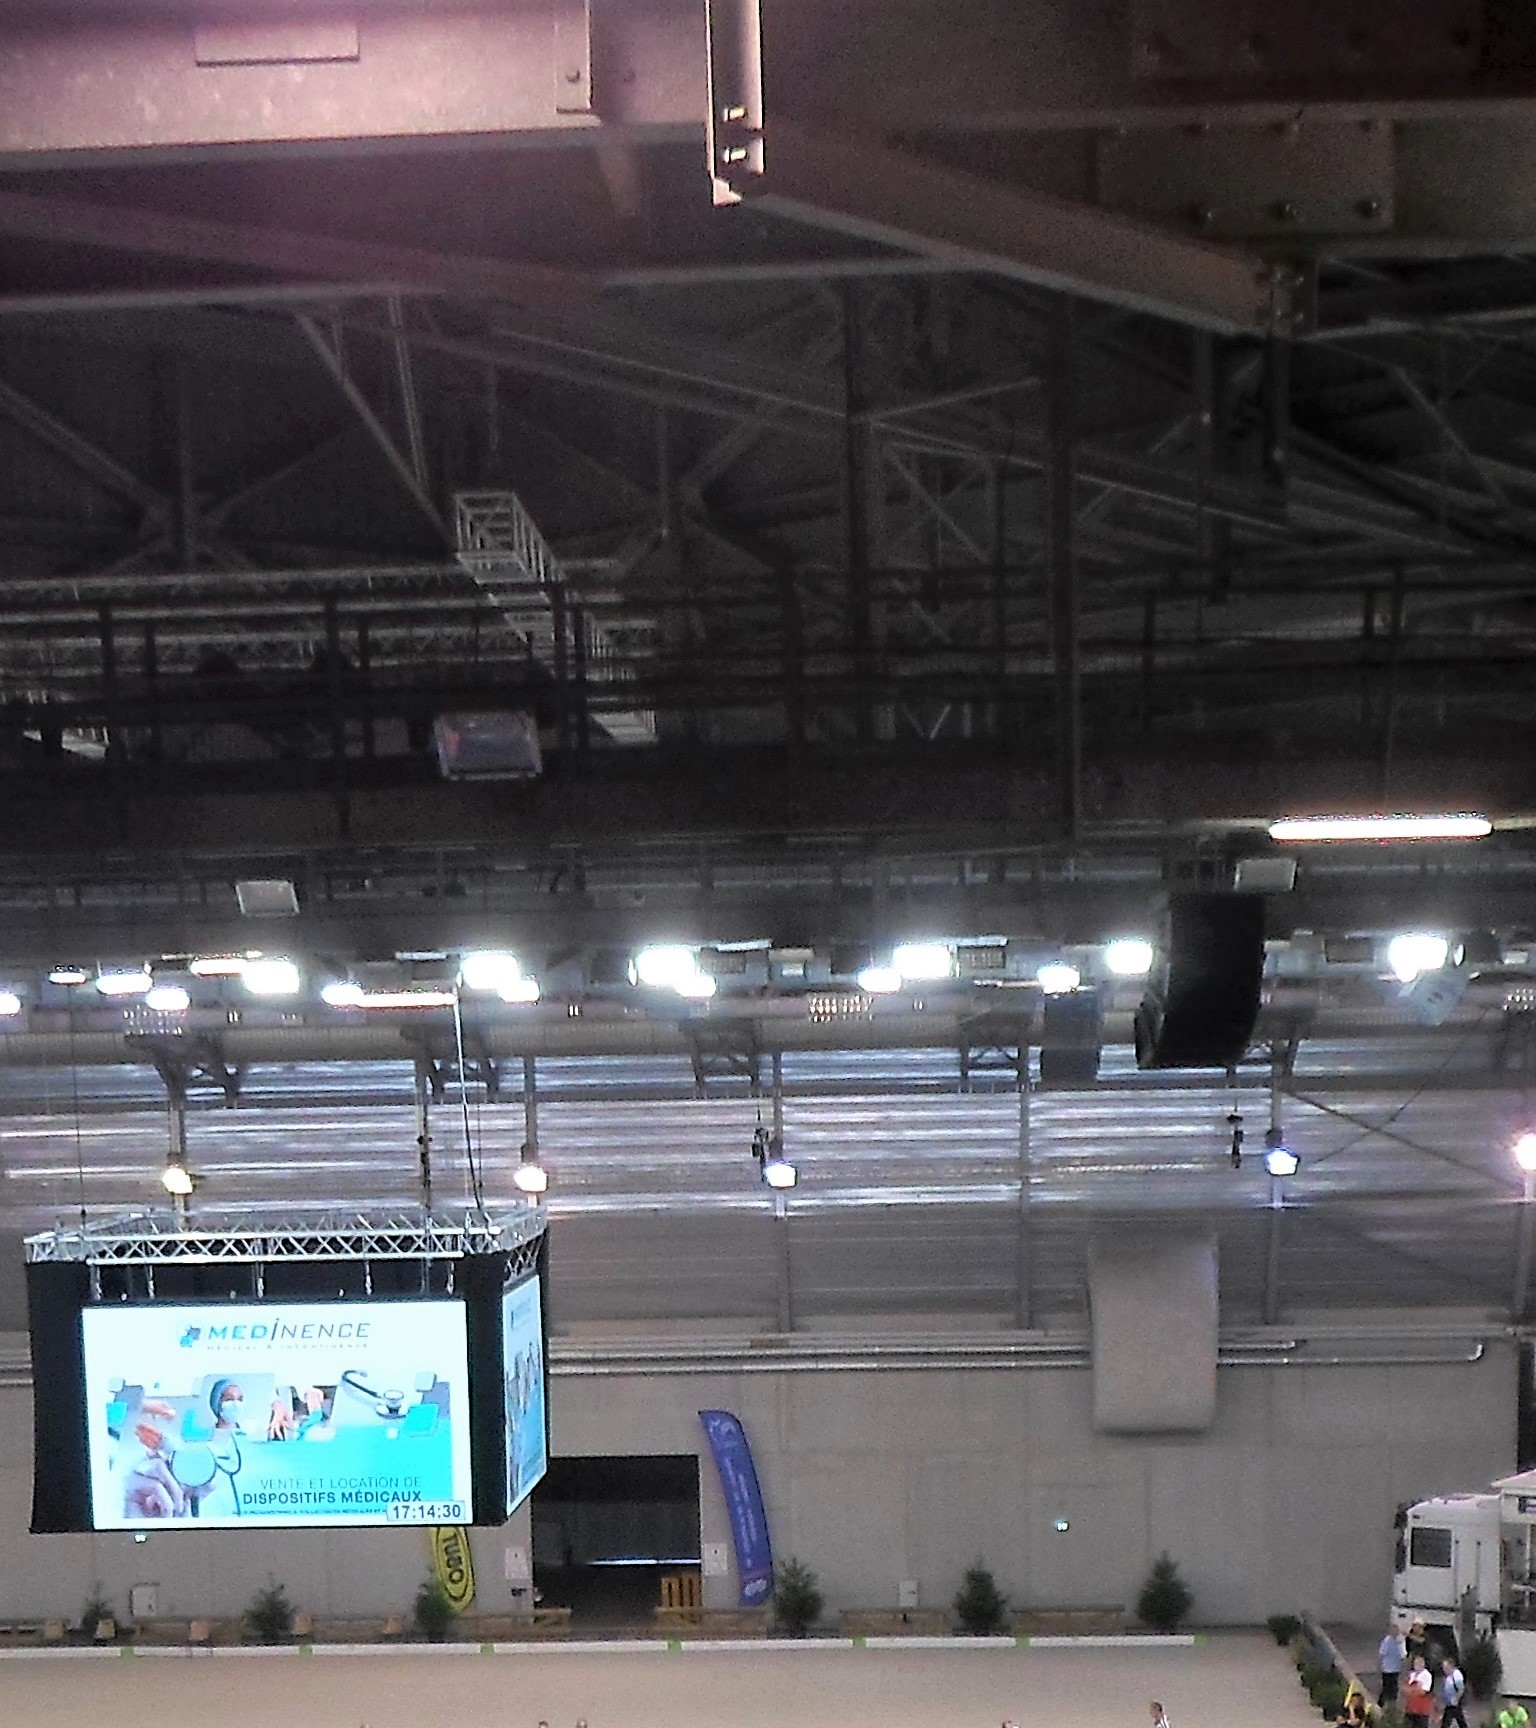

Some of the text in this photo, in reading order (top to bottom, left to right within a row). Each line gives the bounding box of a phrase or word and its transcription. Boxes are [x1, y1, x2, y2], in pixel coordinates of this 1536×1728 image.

[260, 1478, 304, 1490] VENTE
[330, 1476, 399, 1489] LOCATION
[404, 1476, 421, 1487] DE
[242, 1489, 422, 1505] DISPOSITIFS MÉDICAUX
[392, 1504, 462, 1519] 17:14:30
